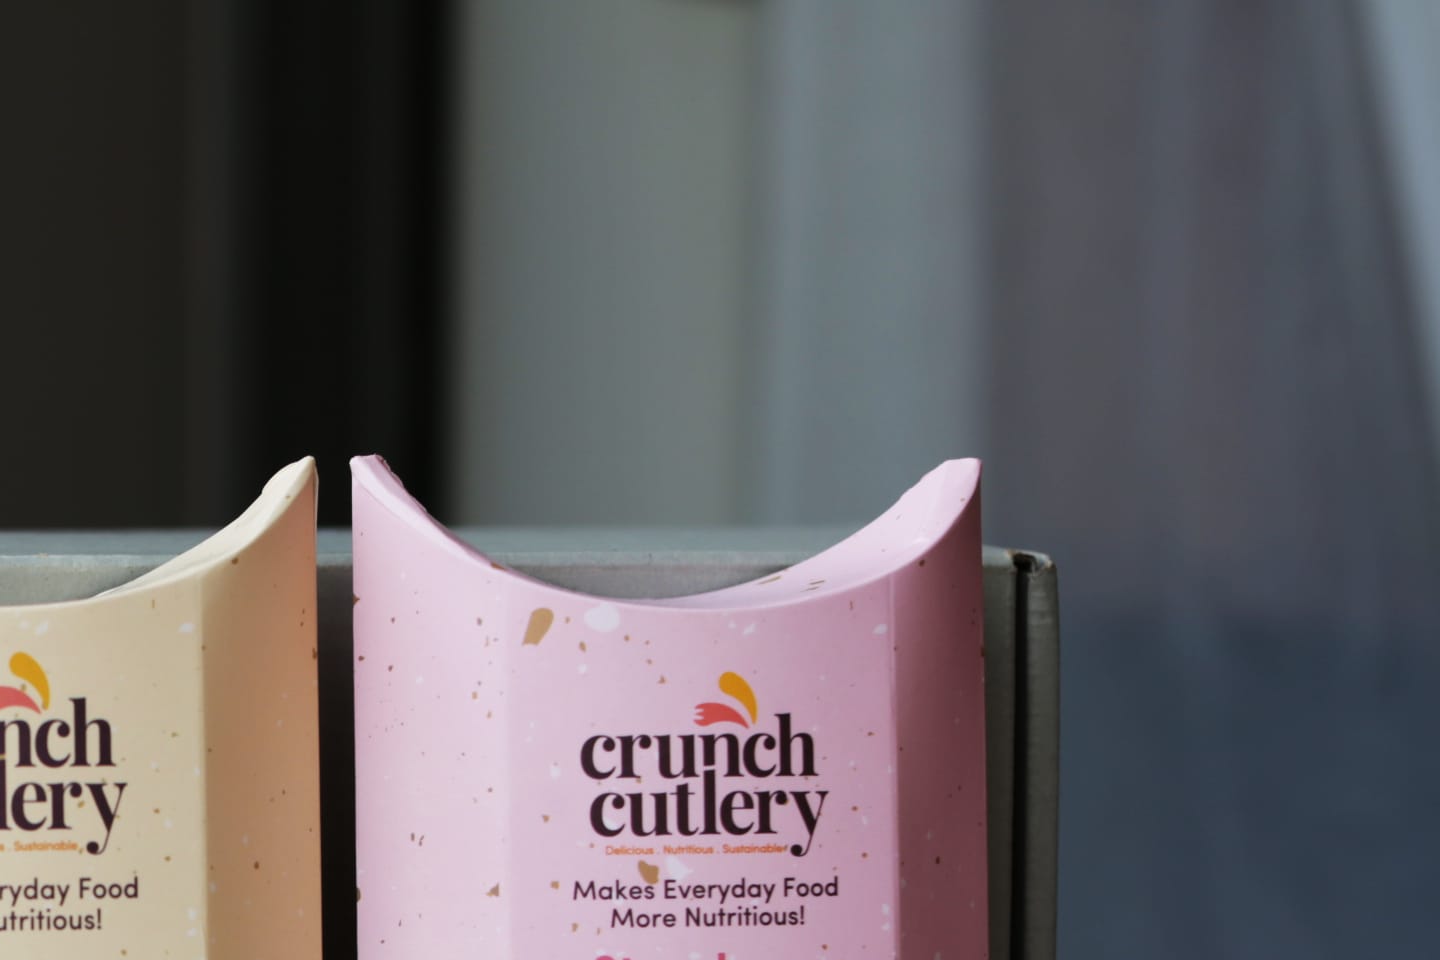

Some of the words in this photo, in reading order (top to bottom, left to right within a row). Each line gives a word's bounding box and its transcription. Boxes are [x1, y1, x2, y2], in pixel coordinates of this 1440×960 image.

[580, 713, 818, 780] crunch
[590, 769, 829, 857] cutlery
[79, 876, 139, 899] Food
[573, 880, 654, 900] Makes
[664, 877, 775, 904] Everyday
[784, 876, 839, 897] Food
[611, 908, 676, 928] More
[686, 905, 805, 927] Nutritious!
